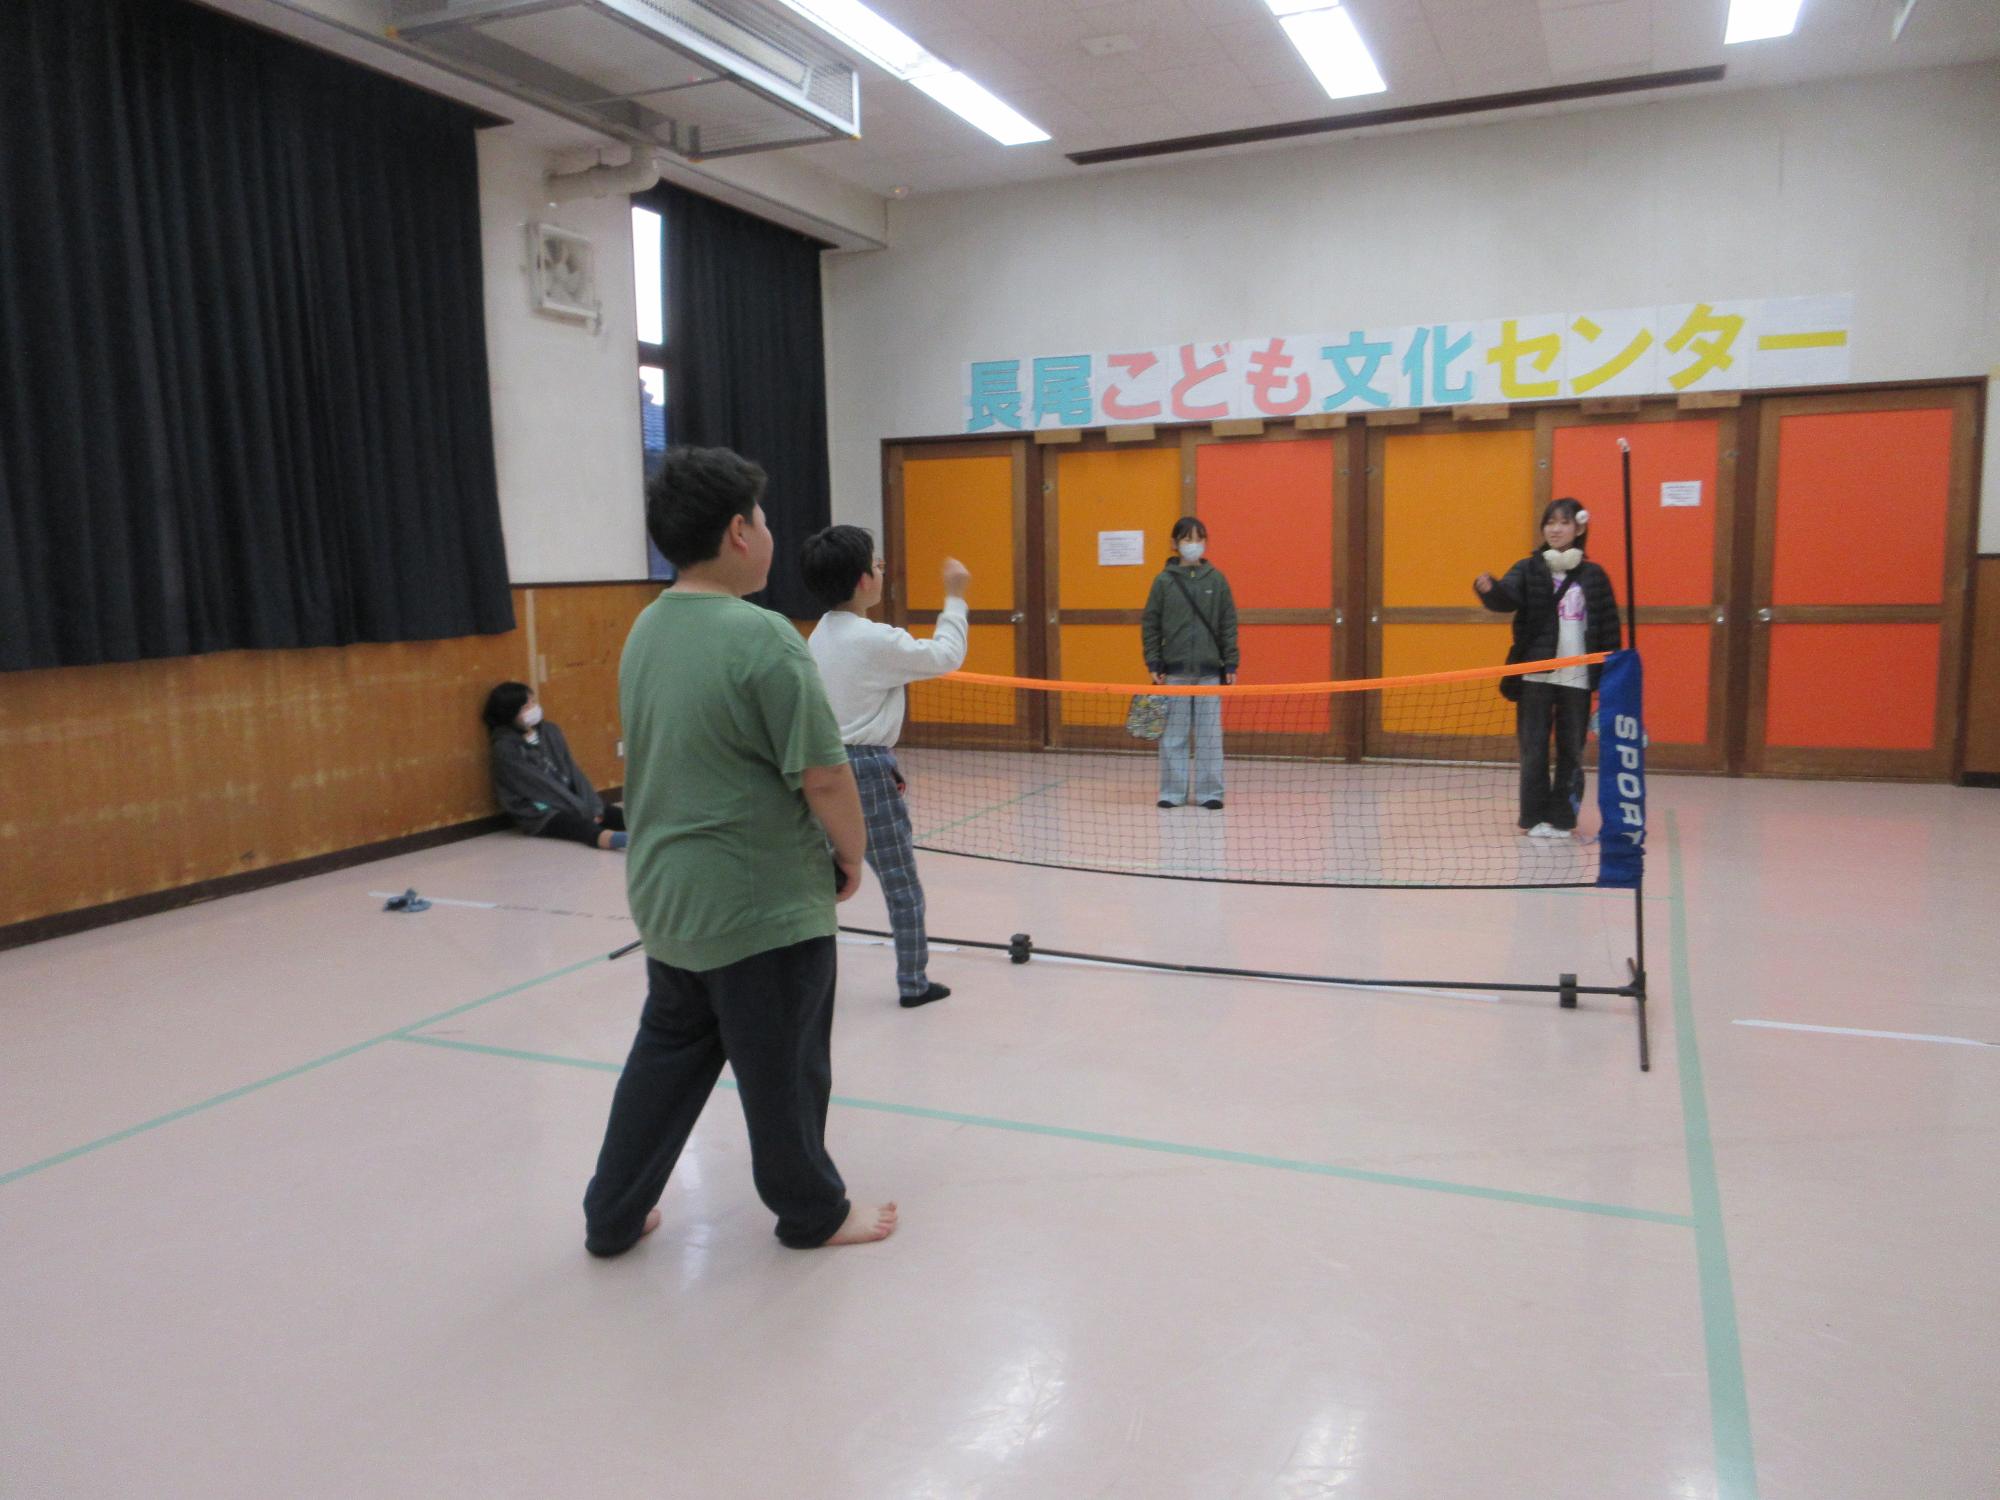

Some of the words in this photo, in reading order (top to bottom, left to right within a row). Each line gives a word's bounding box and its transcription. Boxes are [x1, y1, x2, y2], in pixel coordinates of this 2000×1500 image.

[967, 303, 1847, 432] 長尾こども文化センター
